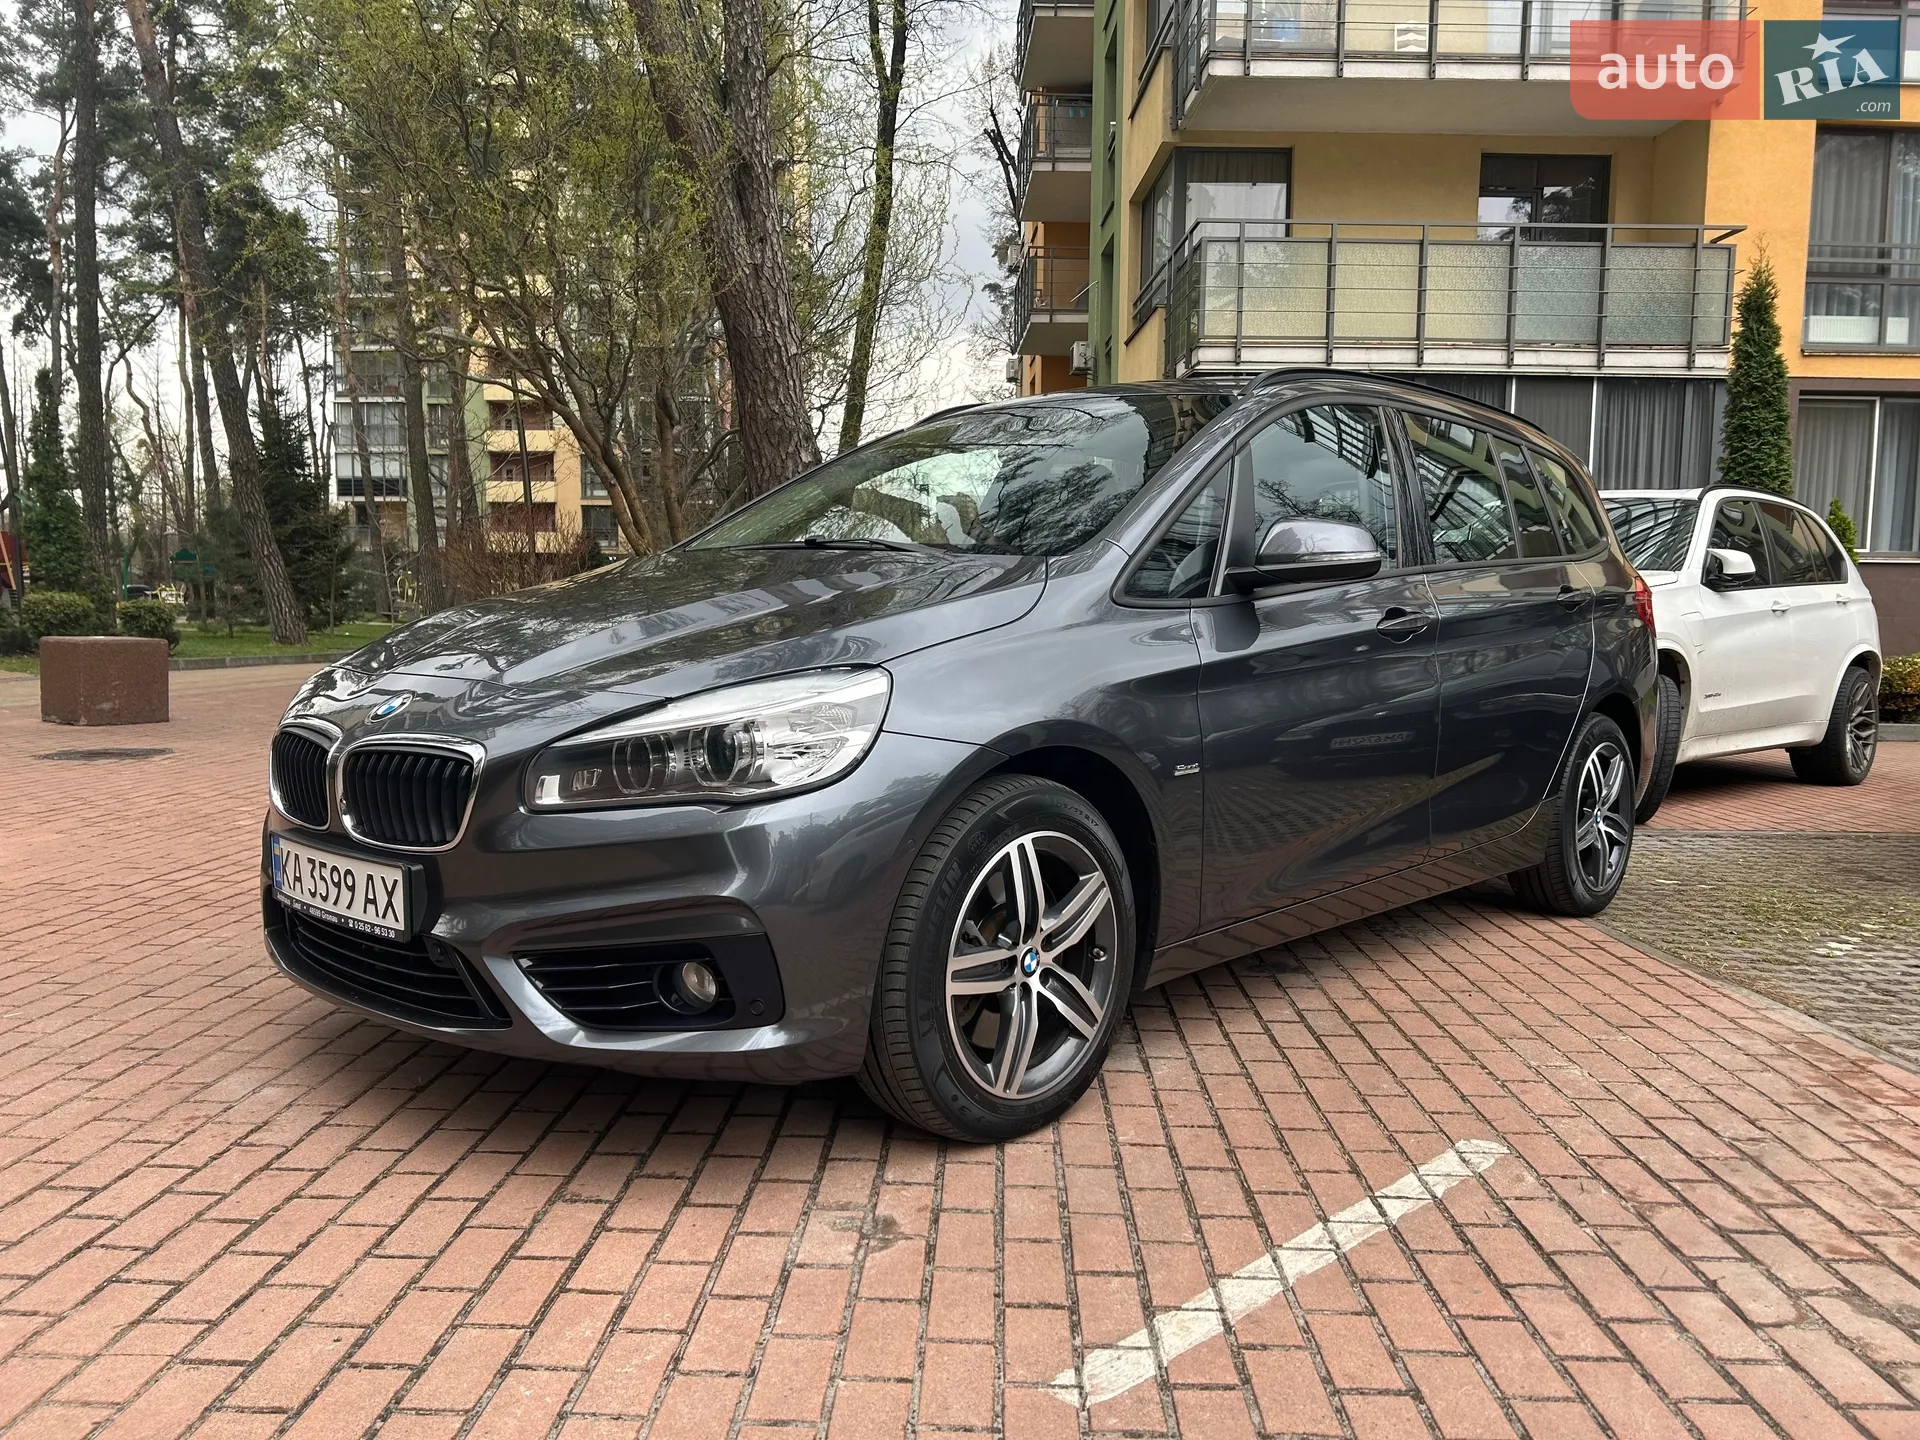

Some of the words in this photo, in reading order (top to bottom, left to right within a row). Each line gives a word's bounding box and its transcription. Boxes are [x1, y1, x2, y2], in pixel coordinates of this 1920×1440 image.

[281, 847, 304, 895] KA
[307, 857, 356, 910] 3599
[363, 874, 399, 922] AX
